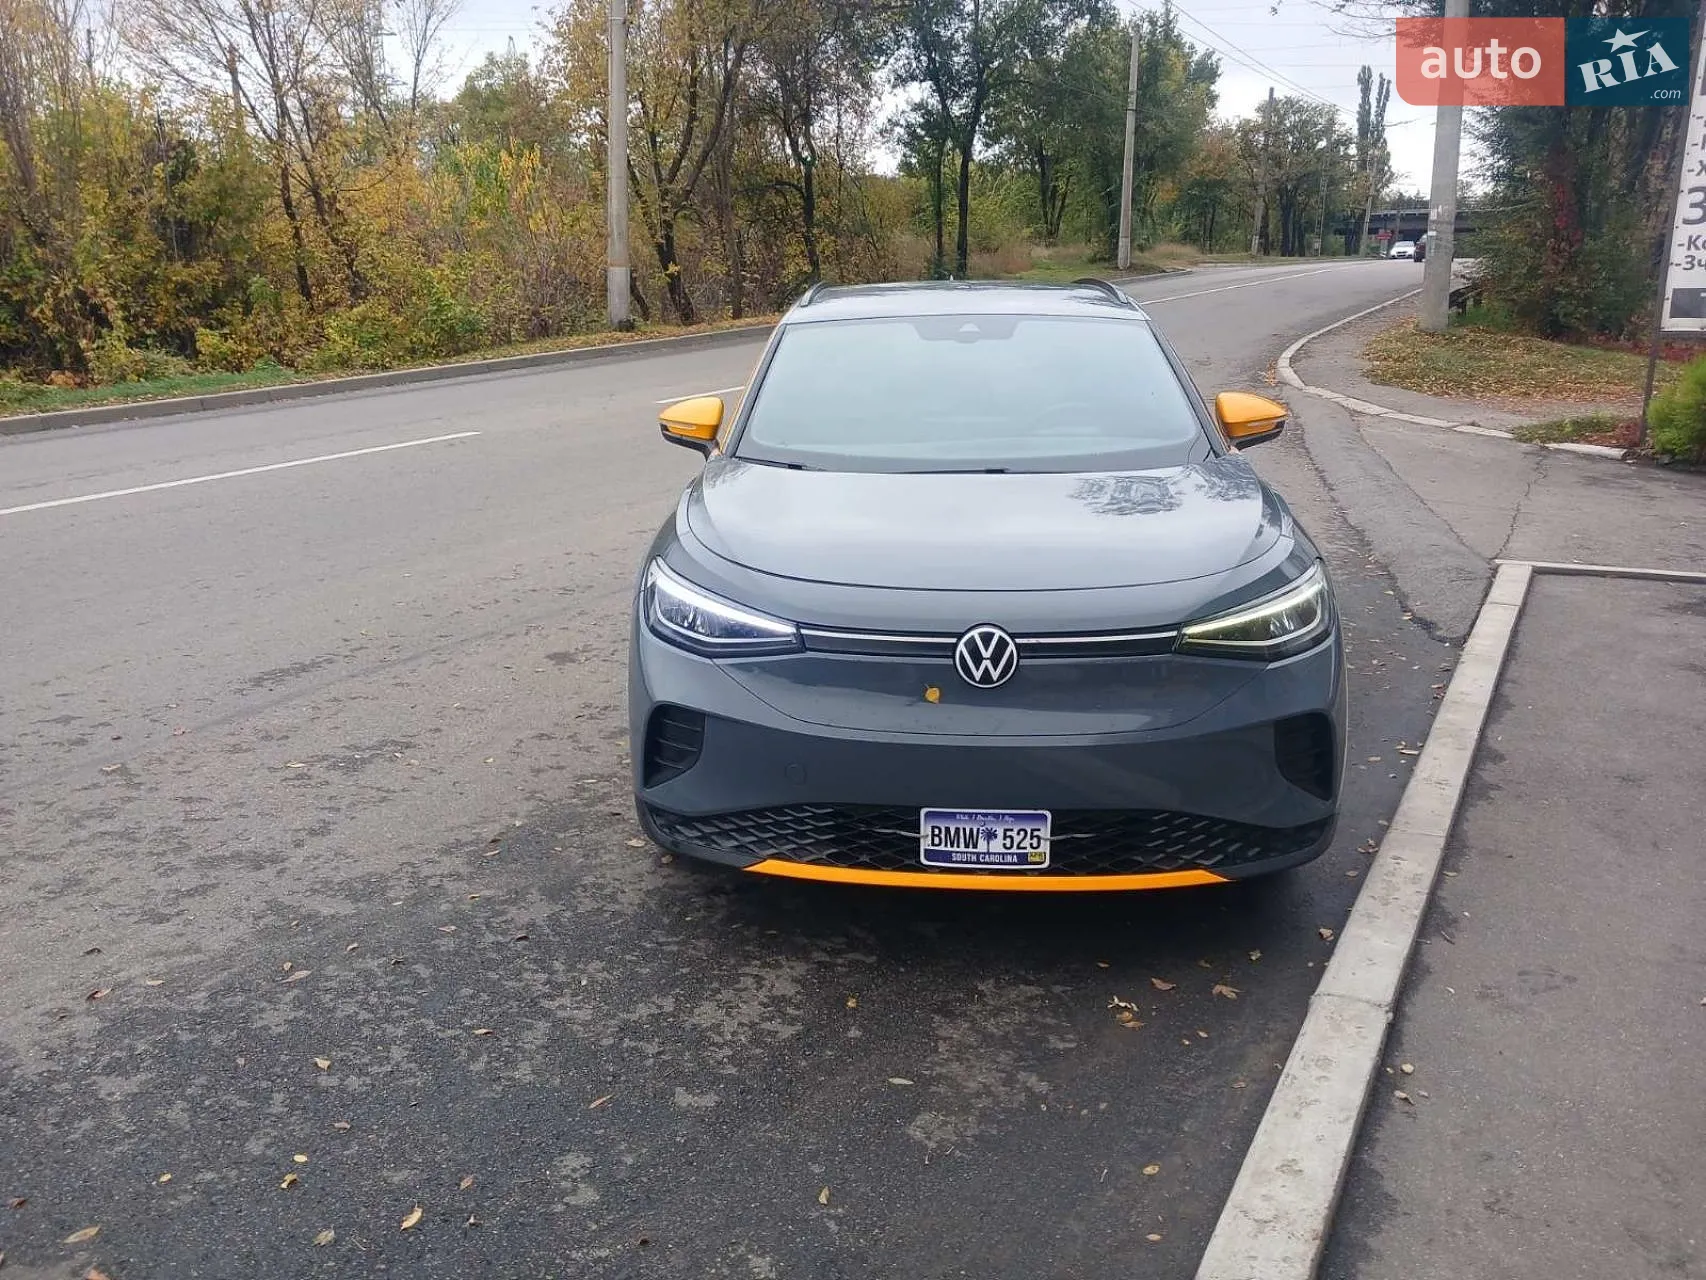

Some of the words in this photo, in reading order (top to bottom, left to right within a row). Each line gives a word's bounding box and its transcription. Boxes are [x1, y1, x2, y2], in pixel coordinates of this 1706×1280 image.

[930, 825, 980, 850] BMW
[1002, 827, 1042, 851] 525
[951, 852, 977, 862] SOUTH
[979, 853, 1018, 863] CAROLINA
